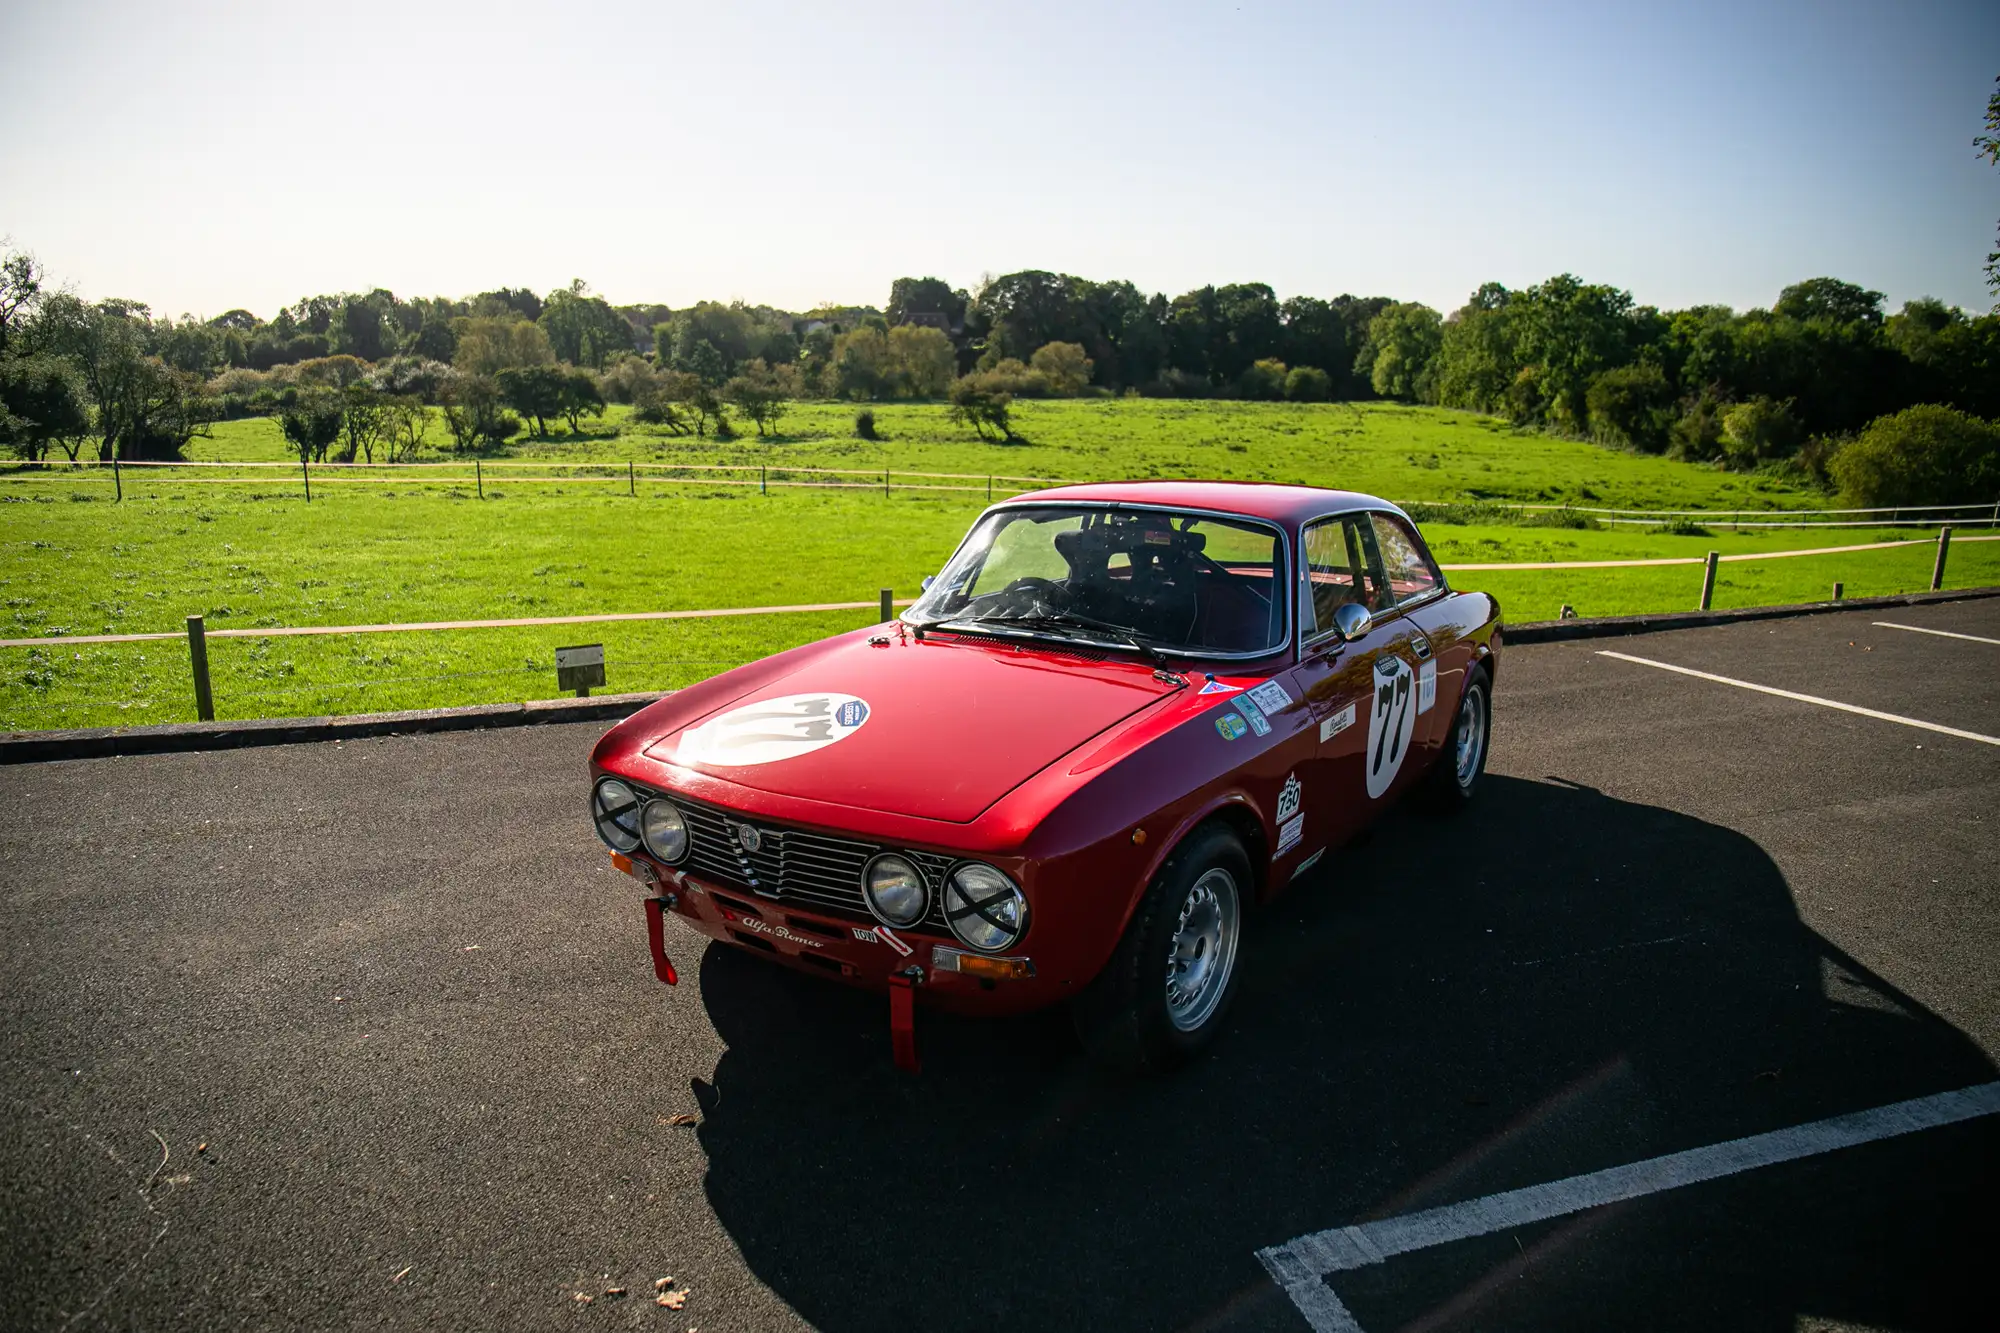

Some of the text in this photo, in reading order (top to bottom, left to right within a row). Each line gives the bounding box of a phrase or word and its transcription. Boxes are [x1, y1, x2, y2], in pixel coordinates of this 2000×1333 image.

[718, 698, 833, 748] 77
[1373, 669, 1411, 776] 77
[1279, 788, 1299, 816] 750
[743, 916, 824, 948] Alfa Romeo
[854, 928, 876, 943] TOW
